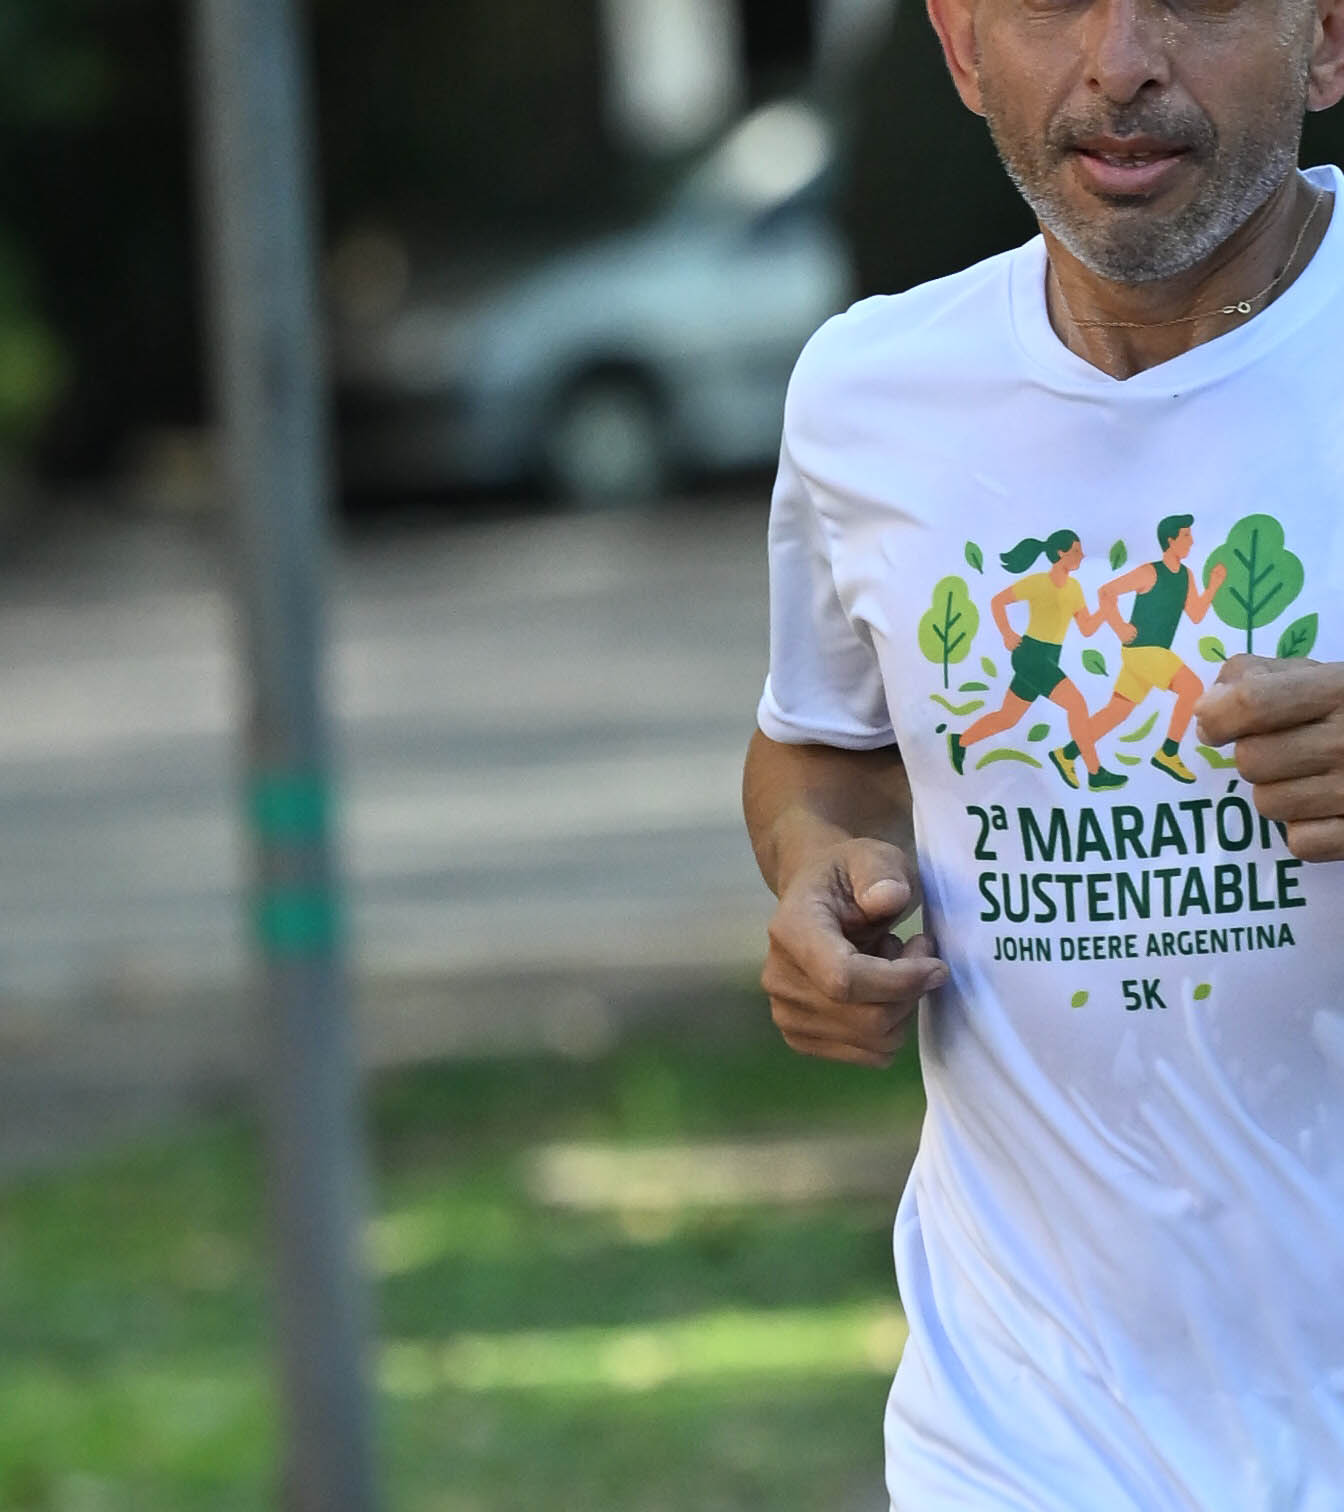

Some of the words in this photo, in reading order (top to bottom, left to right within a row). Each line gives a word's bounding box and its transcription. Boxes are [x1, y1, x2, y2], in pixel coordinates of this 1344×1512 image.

[977, 858, 1307, 924] SUSTENTABLE
[994, 936, 1052, 962] JOHN
[1060, 934, 1139, 961] DEERE
[1146, 922, 1296, 958] ARGENTINA
[1121, 977, 1168, 1012] 5K
